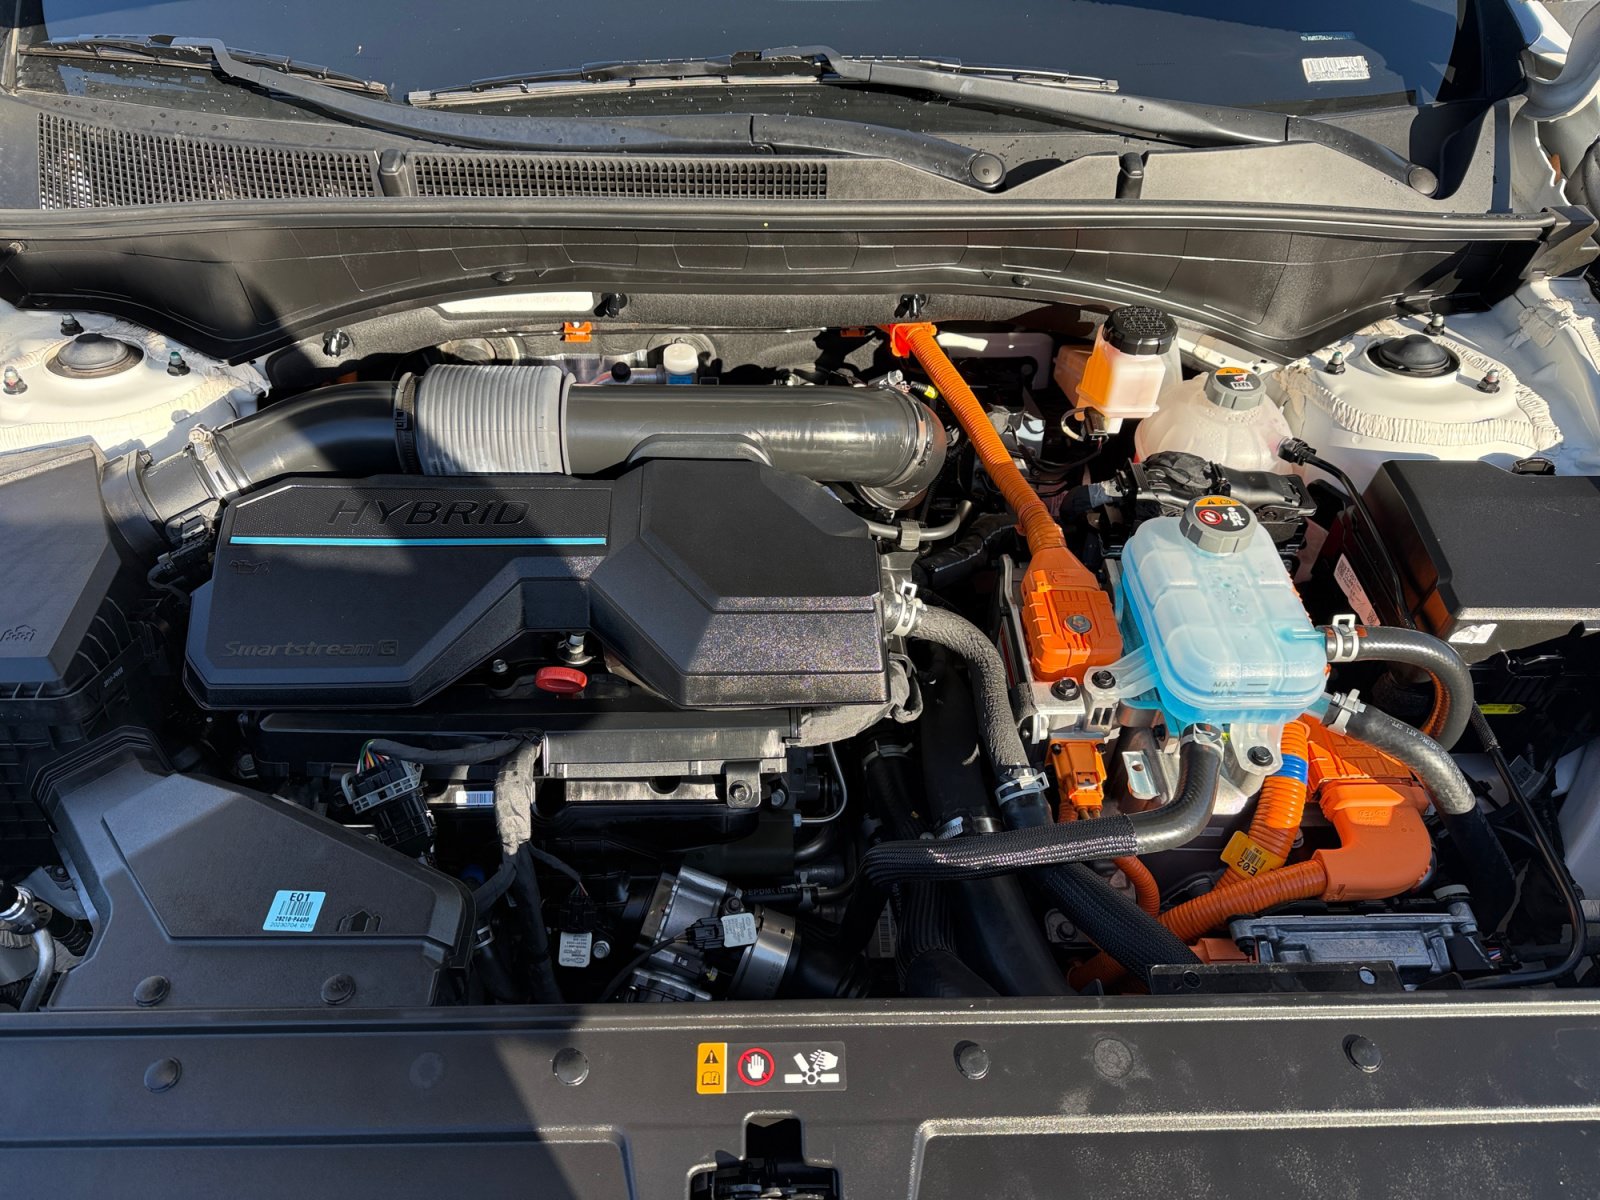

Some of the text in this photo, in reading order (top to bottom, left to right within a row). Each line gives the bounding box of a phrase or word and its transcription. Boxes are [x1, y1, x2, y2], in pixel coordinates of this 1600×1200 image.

[326, 500, 531, 525] HYBRID
[223, 641, 375, 657] Smartstream
[1236, 857, 1258, 877] E02
[289, 892, 311, 902] E01
